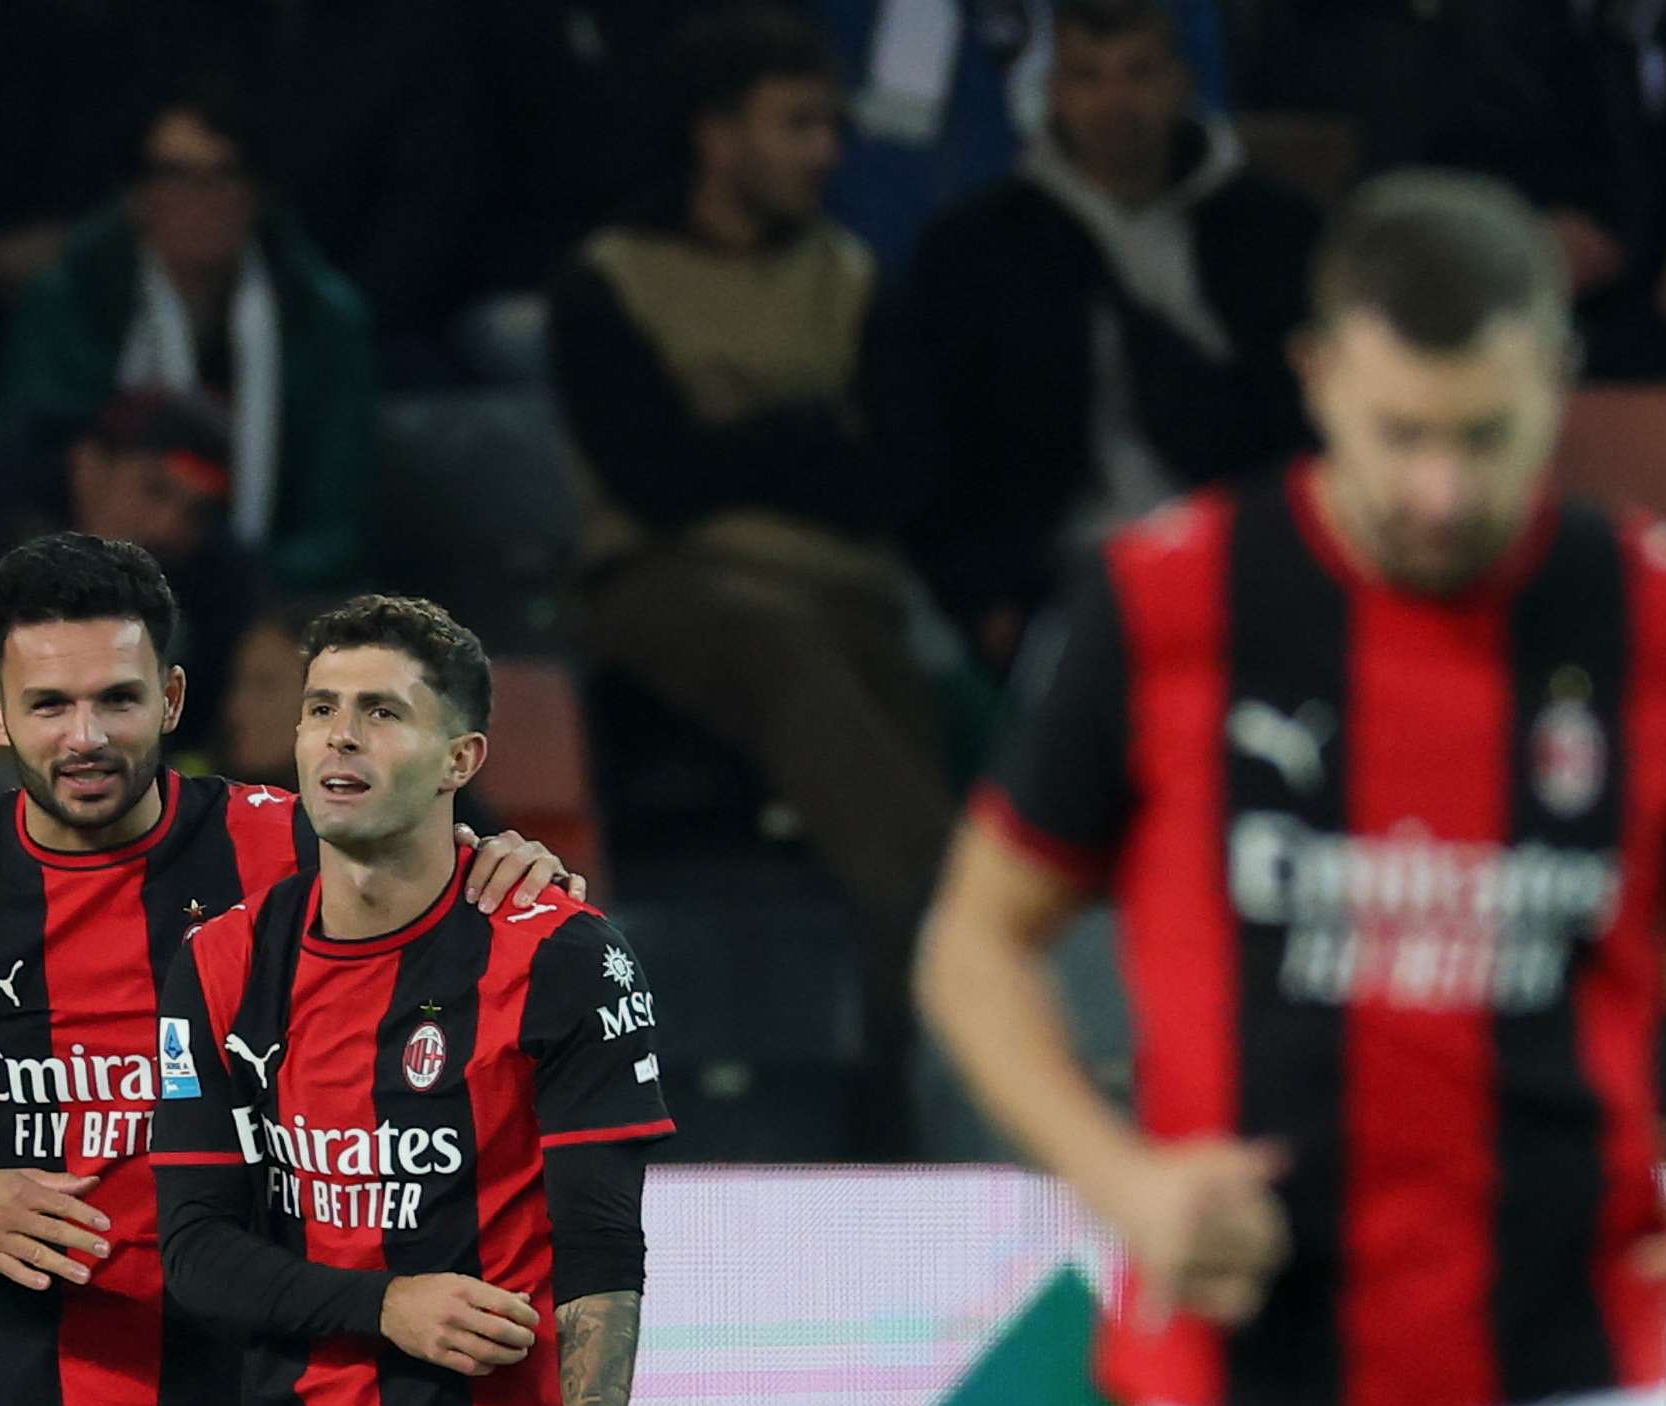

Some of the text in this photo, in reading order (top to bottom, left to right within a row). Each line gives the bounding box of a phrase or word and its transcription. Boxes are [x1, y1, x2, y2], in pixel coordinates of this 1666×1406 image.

[14, 1112, 70, 1158] FLY
[232, 1105, 463, 1176] Emirates
[266, 1166, 423, 1229] FLY BETTER
